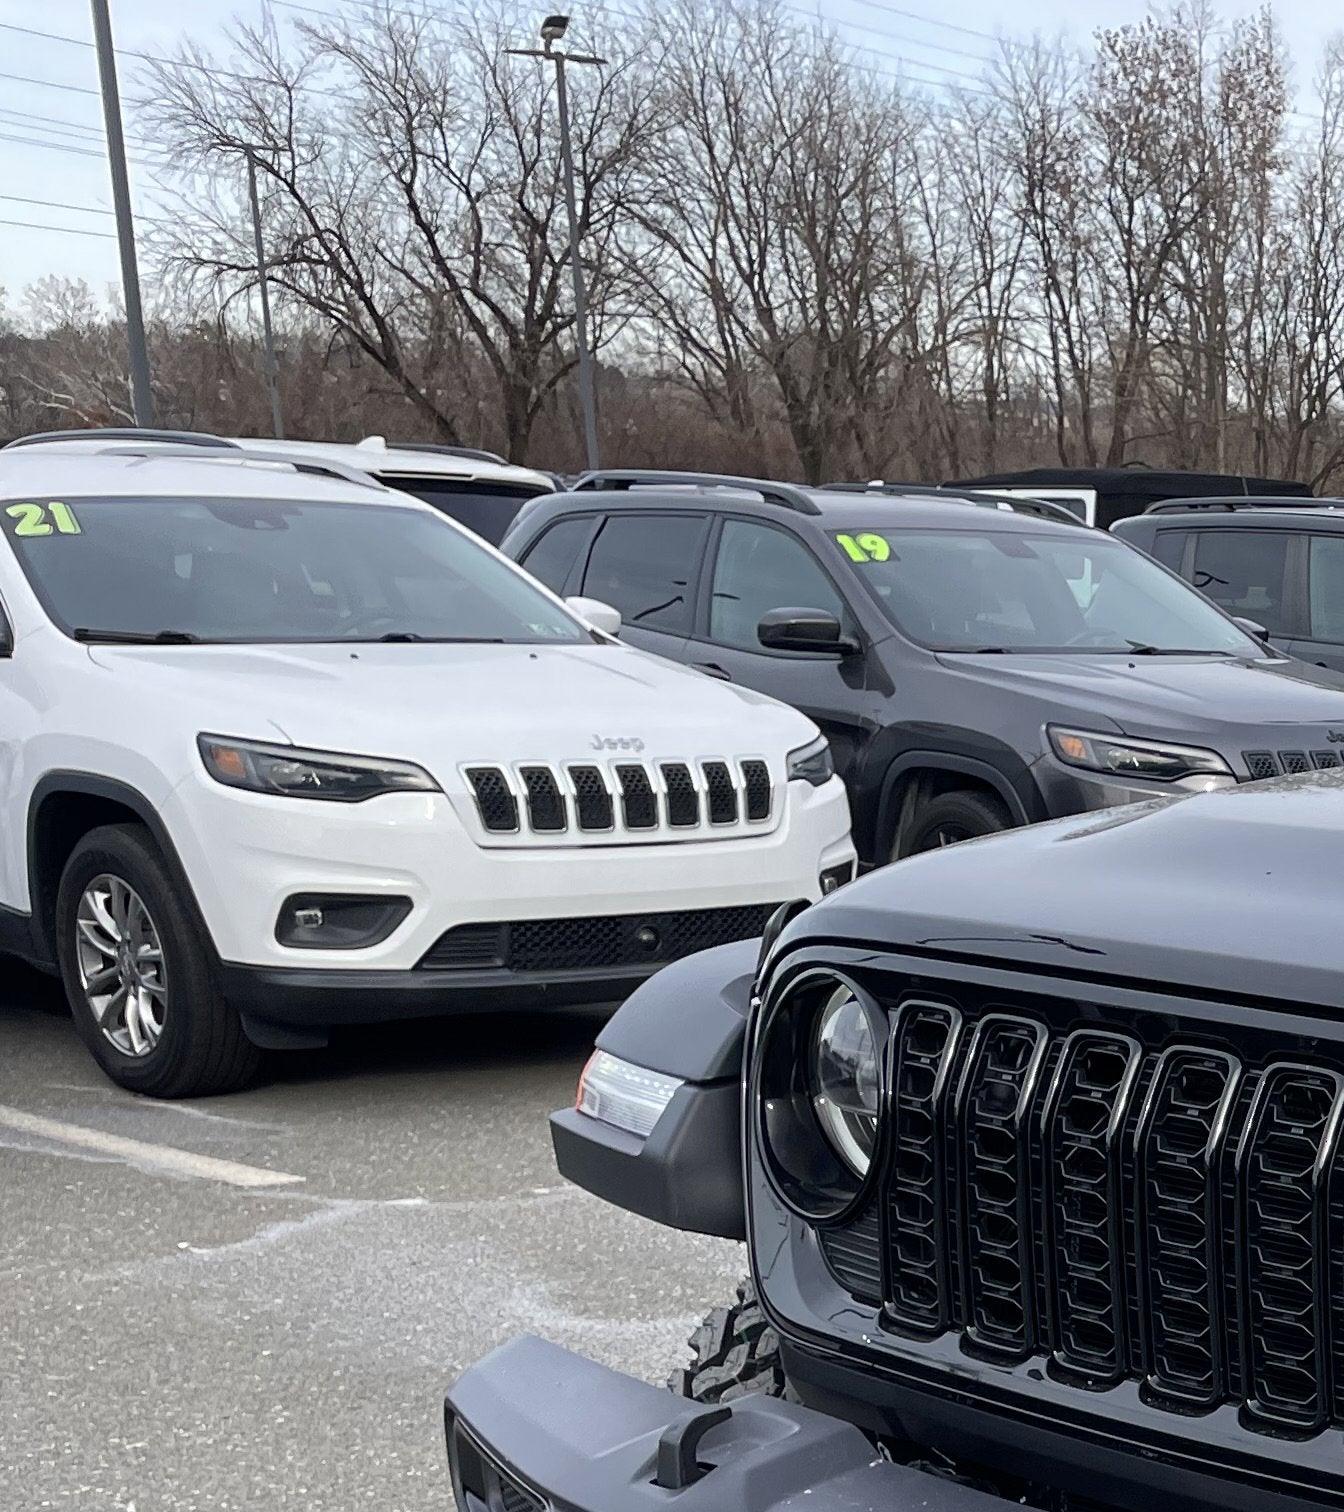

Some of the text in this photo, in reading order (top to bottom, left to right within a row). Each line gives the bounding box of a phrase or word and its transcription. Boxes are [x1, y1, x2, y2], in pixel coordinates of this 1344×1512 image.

[5, 502, 81, 536] 21
[836, 532, 890, 562] 19
[589, 733, 645, 752] Jeep
